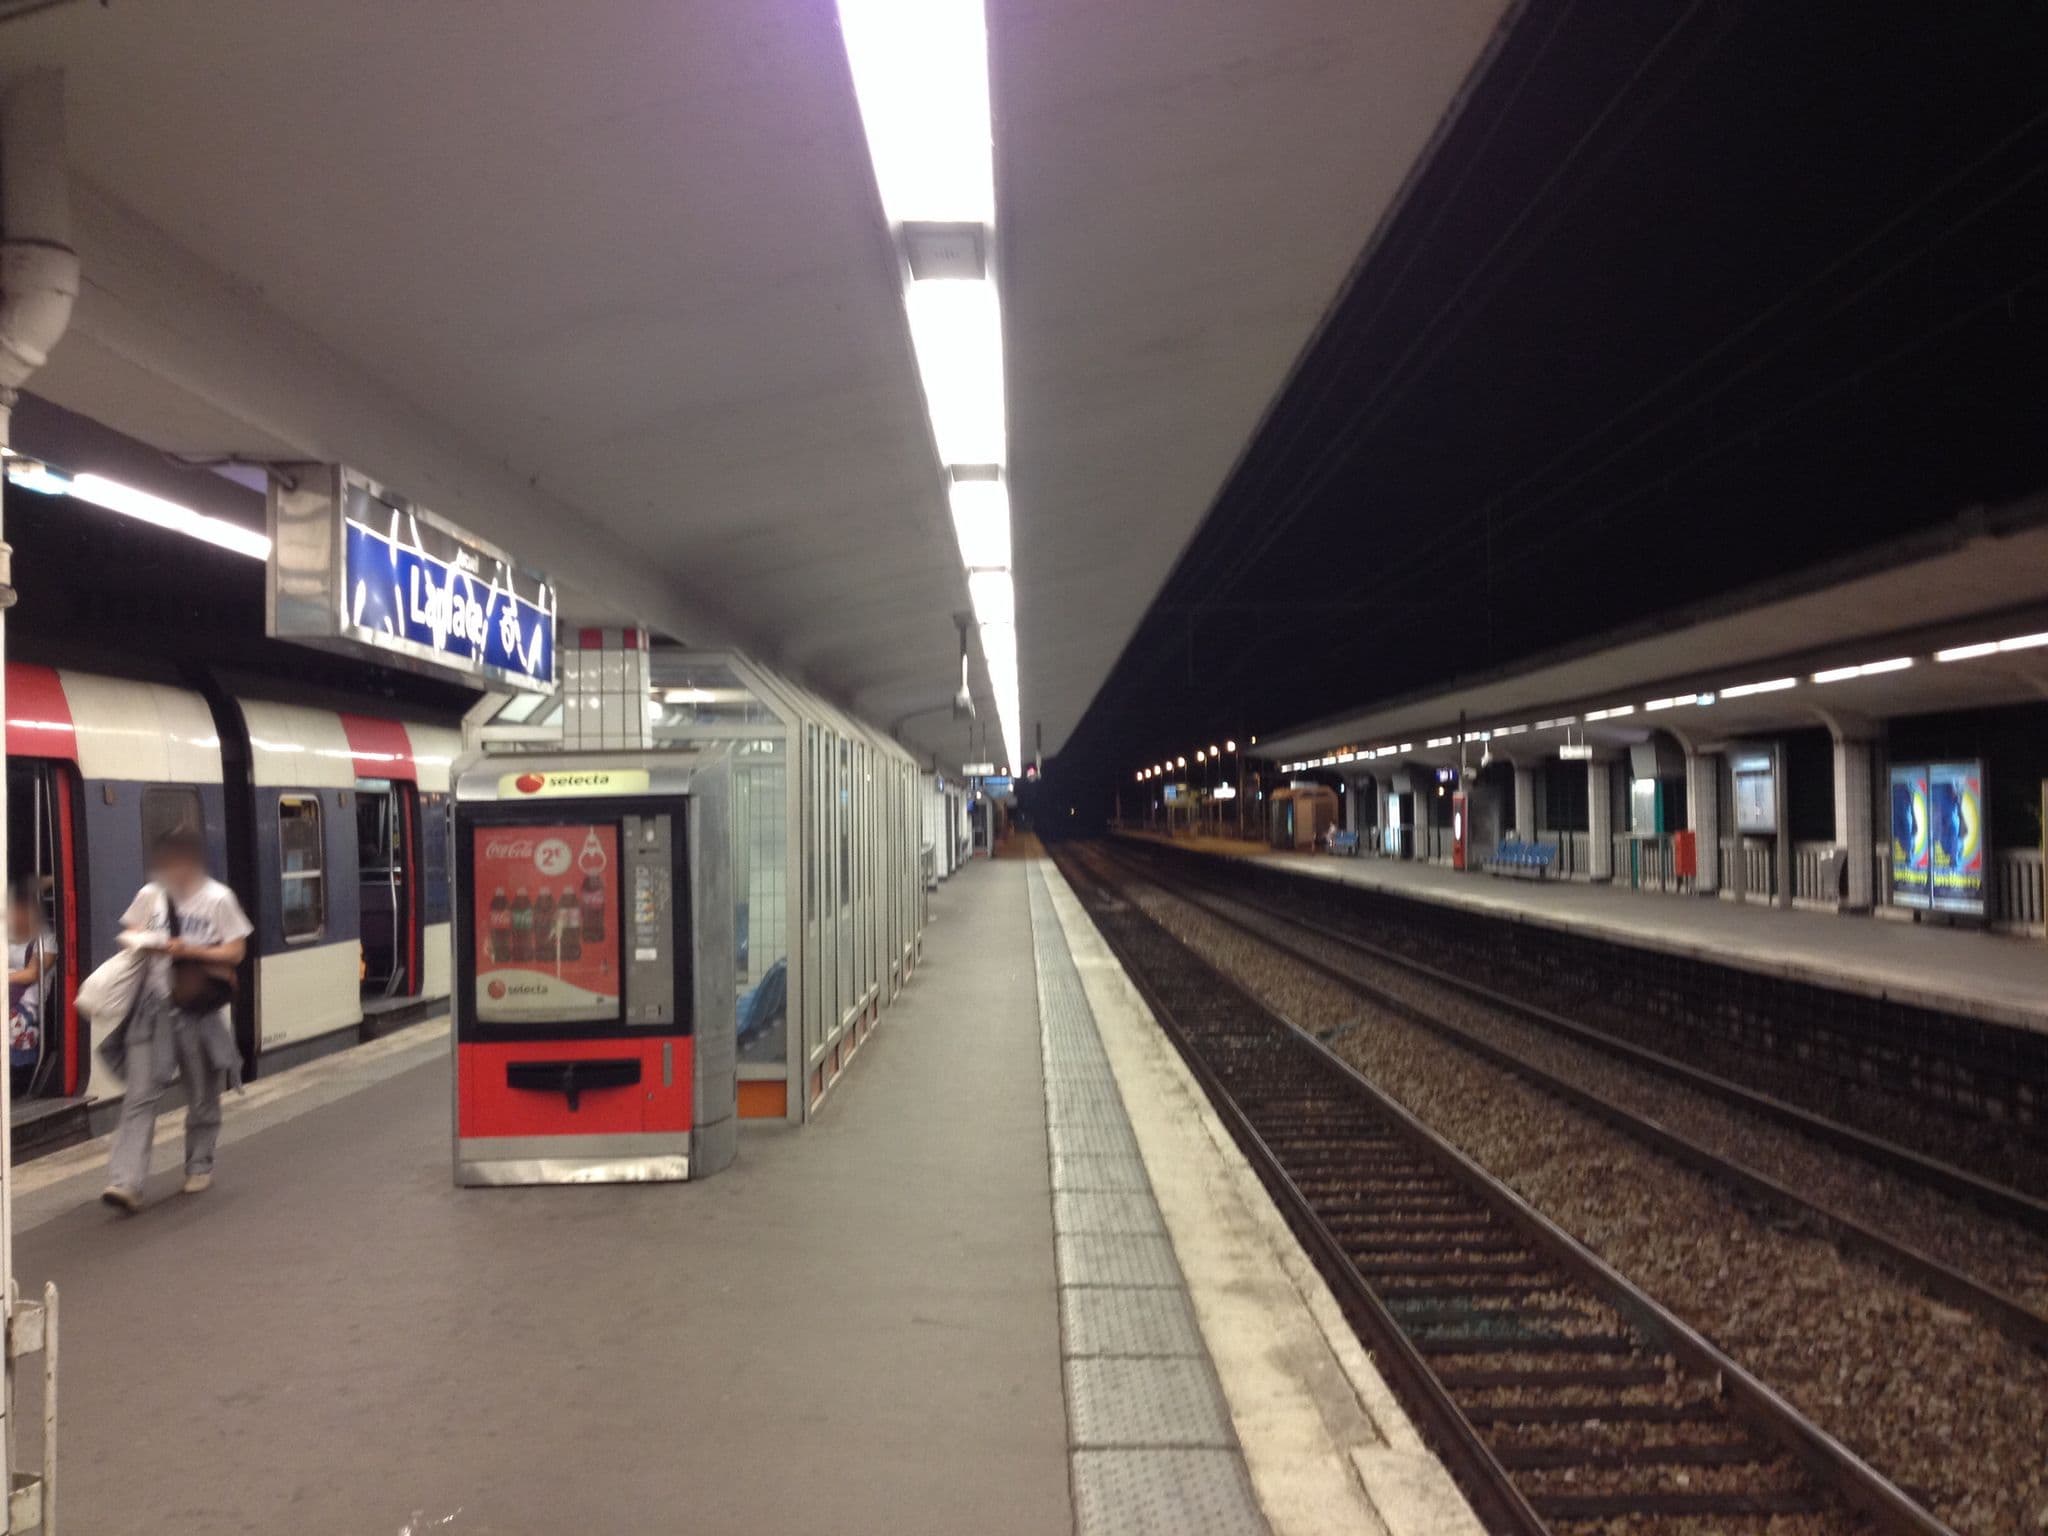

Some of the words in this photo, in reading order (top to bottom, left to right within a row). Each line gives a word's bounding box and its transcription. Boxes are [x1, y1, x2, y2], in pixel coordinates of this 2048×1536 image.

[410, 563, 483, 649] Laplace
[549, 774, 610, 787] selecta
[508, 983, 549, 996] selecta
